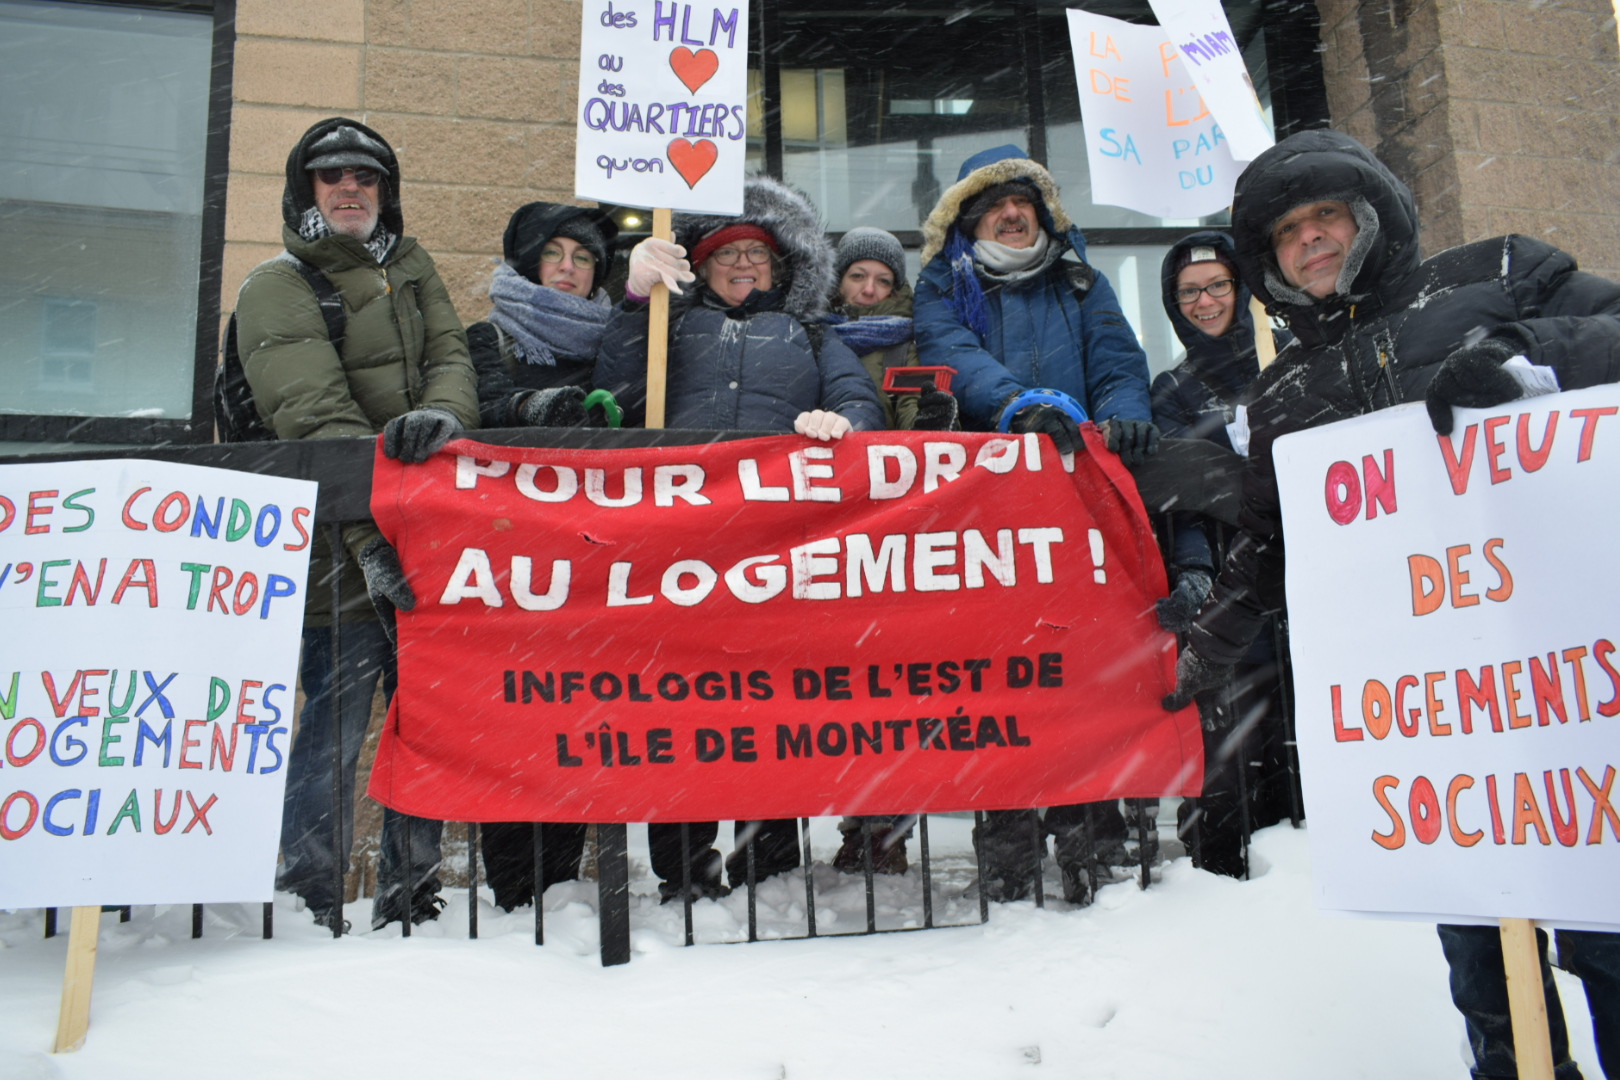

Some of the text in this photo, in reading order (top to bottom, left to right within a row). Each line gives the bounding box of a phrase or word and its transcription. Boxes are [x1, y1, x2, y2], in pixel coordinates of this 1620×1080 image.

[600, 0, 739, 48] des HLM
[1089, 31, 1122, 62] LA
[597, 79, 626, 97] des
[598, 54, 624, 72] au
[1089, 68, 1133, 102] DE
[583, 97, 745, 140] QUARTIERS
[1099, 124, 1227, 165] SA PAR
[596, 154, 664, 179] qu'on
[1178, 164, 1214, 190] DU
[454, 455, 713, 508] POUR
[737, 446, 842, 502] LE
[1324, 406, 1618, 526] ON VEUT
[121, 486, 311, 552] CONDOS
[180, 562, 297, 619] TROP
[439, 547, 573, 611] AU
[605, 527, 1064, 608] LOGEMENT
[1407, 537, 1514, 616] DES
[41, 669, 179, 719] VEUX
[206, 676, 287, 726] DES
[503, 652, 1063, 704] INFOLOGIS DE L'EST DE
[1330, 639, 1620, 743] LOGEMENTS
[0, 716, 288, 774] OGEMENTS
[556, 706, 1031, 768] L'ÎLE DE MONTRÉAL
[1372, 763, 1620, 850] SOCIAUX
